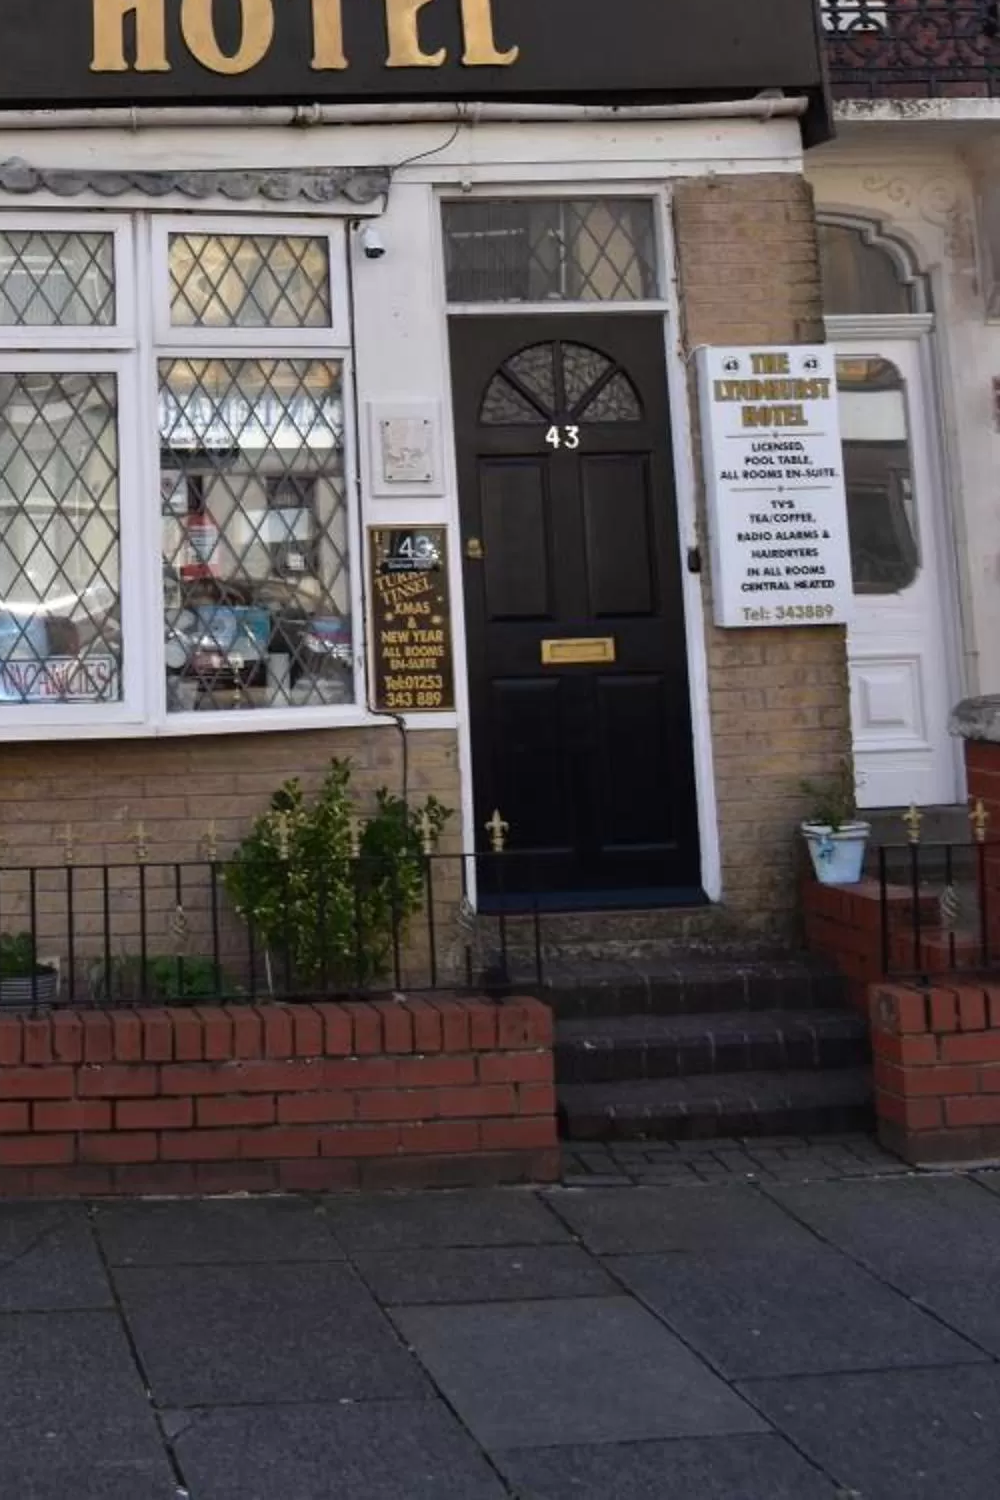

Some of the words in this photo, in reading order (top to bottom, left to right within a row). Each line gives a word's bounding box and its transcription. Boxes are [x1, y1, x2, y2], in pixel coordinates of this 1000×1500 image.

[724, 360, 739, 371] 43
[750, 353, 790, 374] THE
[803, 359, 818, 369] 43
[742, 404, 808, 427] HOTEL
[545, 425, 579, 449] 43
[751, 442, 804, 452] LICENSED,
[744, 456, 775, 465] POOL
[720, 471, 738, 480] ALL
[742, 469, 782, 479] ROOMS
[737, 531, 772, 542] RADIO
[775, 530, 819, 541] ALARMS
[822, 529, 831, 539] &
[399, 535, 431, 557] 43
[751, 548, 819, 559] HAIRDRYERS
[747, 567, 760, 577] IN
[763, 567, 782, 576] ALL
[785, 565, 826, 575] ROOMS
[741, 581, 791, 592] CENTRAL
[794, 579, 835, 589] HEATED
[394, 601, 432, 615] XMAS
[743, 606, 772, 620] Tel:
[382, 631, 410, 643] NEW
[412, 630, 444, 643] YEAR
[383, 647, 401, 658] ALL
[405, 645, 444, 657] ROOMS
[386, 693, 413, 707] 343
[415, 691, 442, 706] 889
